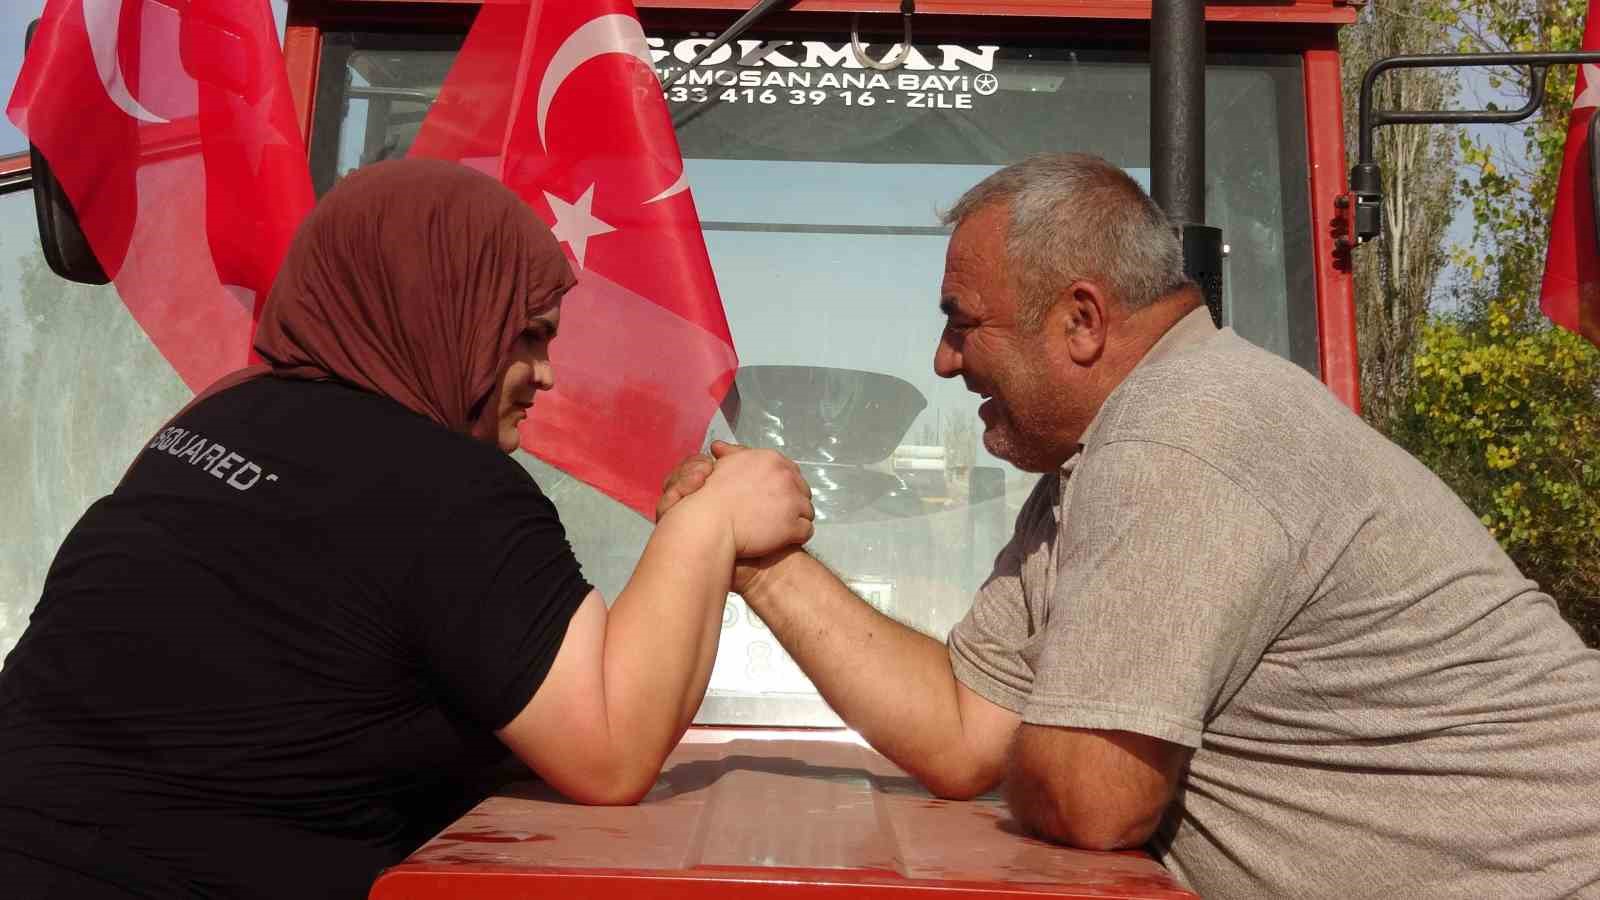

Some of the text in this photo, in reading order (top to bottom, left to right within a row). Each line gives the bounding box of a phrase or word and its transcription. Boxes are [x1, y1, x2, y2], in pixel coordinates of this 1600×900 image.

[656, 66, 811, 88] ÜMOSAN
[817, 72, 890, 90] ANA
[663, 87, 708, 103] 33
[719, 88, 777, 104] 416
[788, 90, 827, 106] 39
[839, 91, 876, 107] 16
